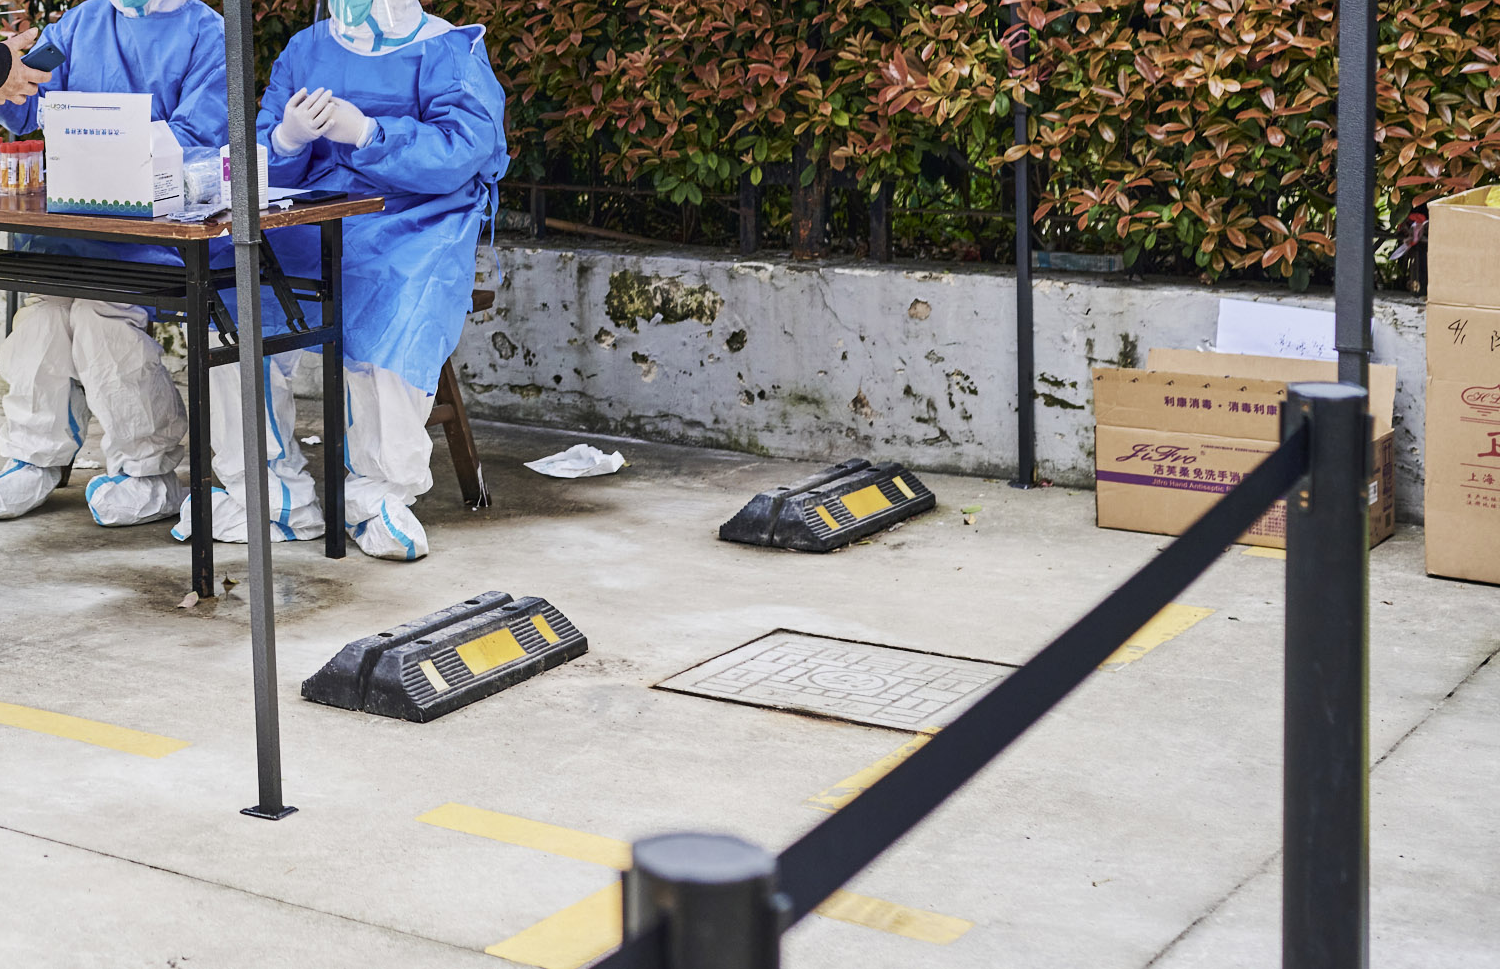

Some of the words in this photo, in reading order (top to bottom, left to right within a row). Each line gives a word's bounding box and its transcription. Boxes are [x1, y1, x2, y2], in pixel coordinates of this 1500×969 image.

[1115, 443, 1198, 465] JiFro
[1467, 472, 1496, 485] 上海
[1169, 480, 1188, 488] Hand
[1189, 482, 1224, 493] Antiseptic
